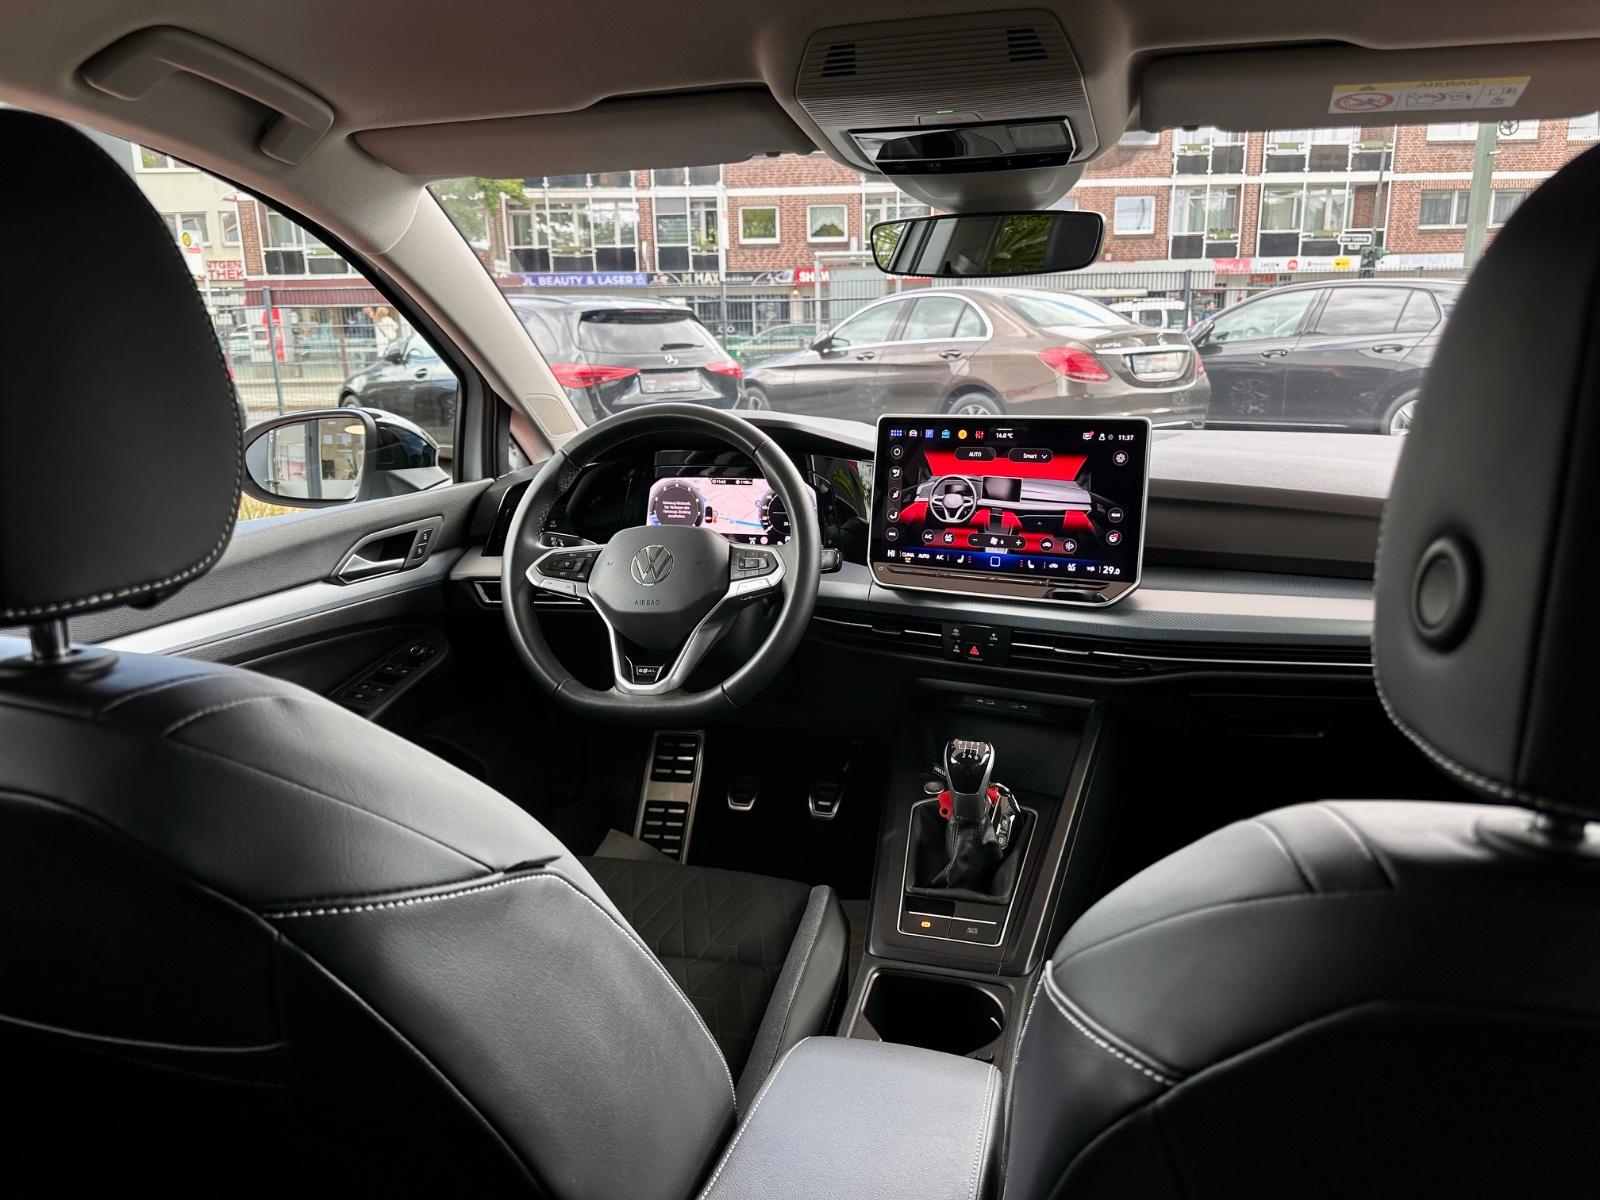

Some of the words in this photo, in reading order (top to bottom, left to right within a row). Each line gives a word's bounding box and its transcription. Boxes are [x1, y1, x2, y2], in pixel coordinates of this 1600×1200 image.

[1416, 79, 1480, 88] AIRBAG
[538, 275, 583, 287] BEAUTY
[586, 275, 595, 286] &
[597, 275, 633, 286] LASER
[887, 549, 896, 557] HI
[1102, 565, 1121, 575] 29.0
